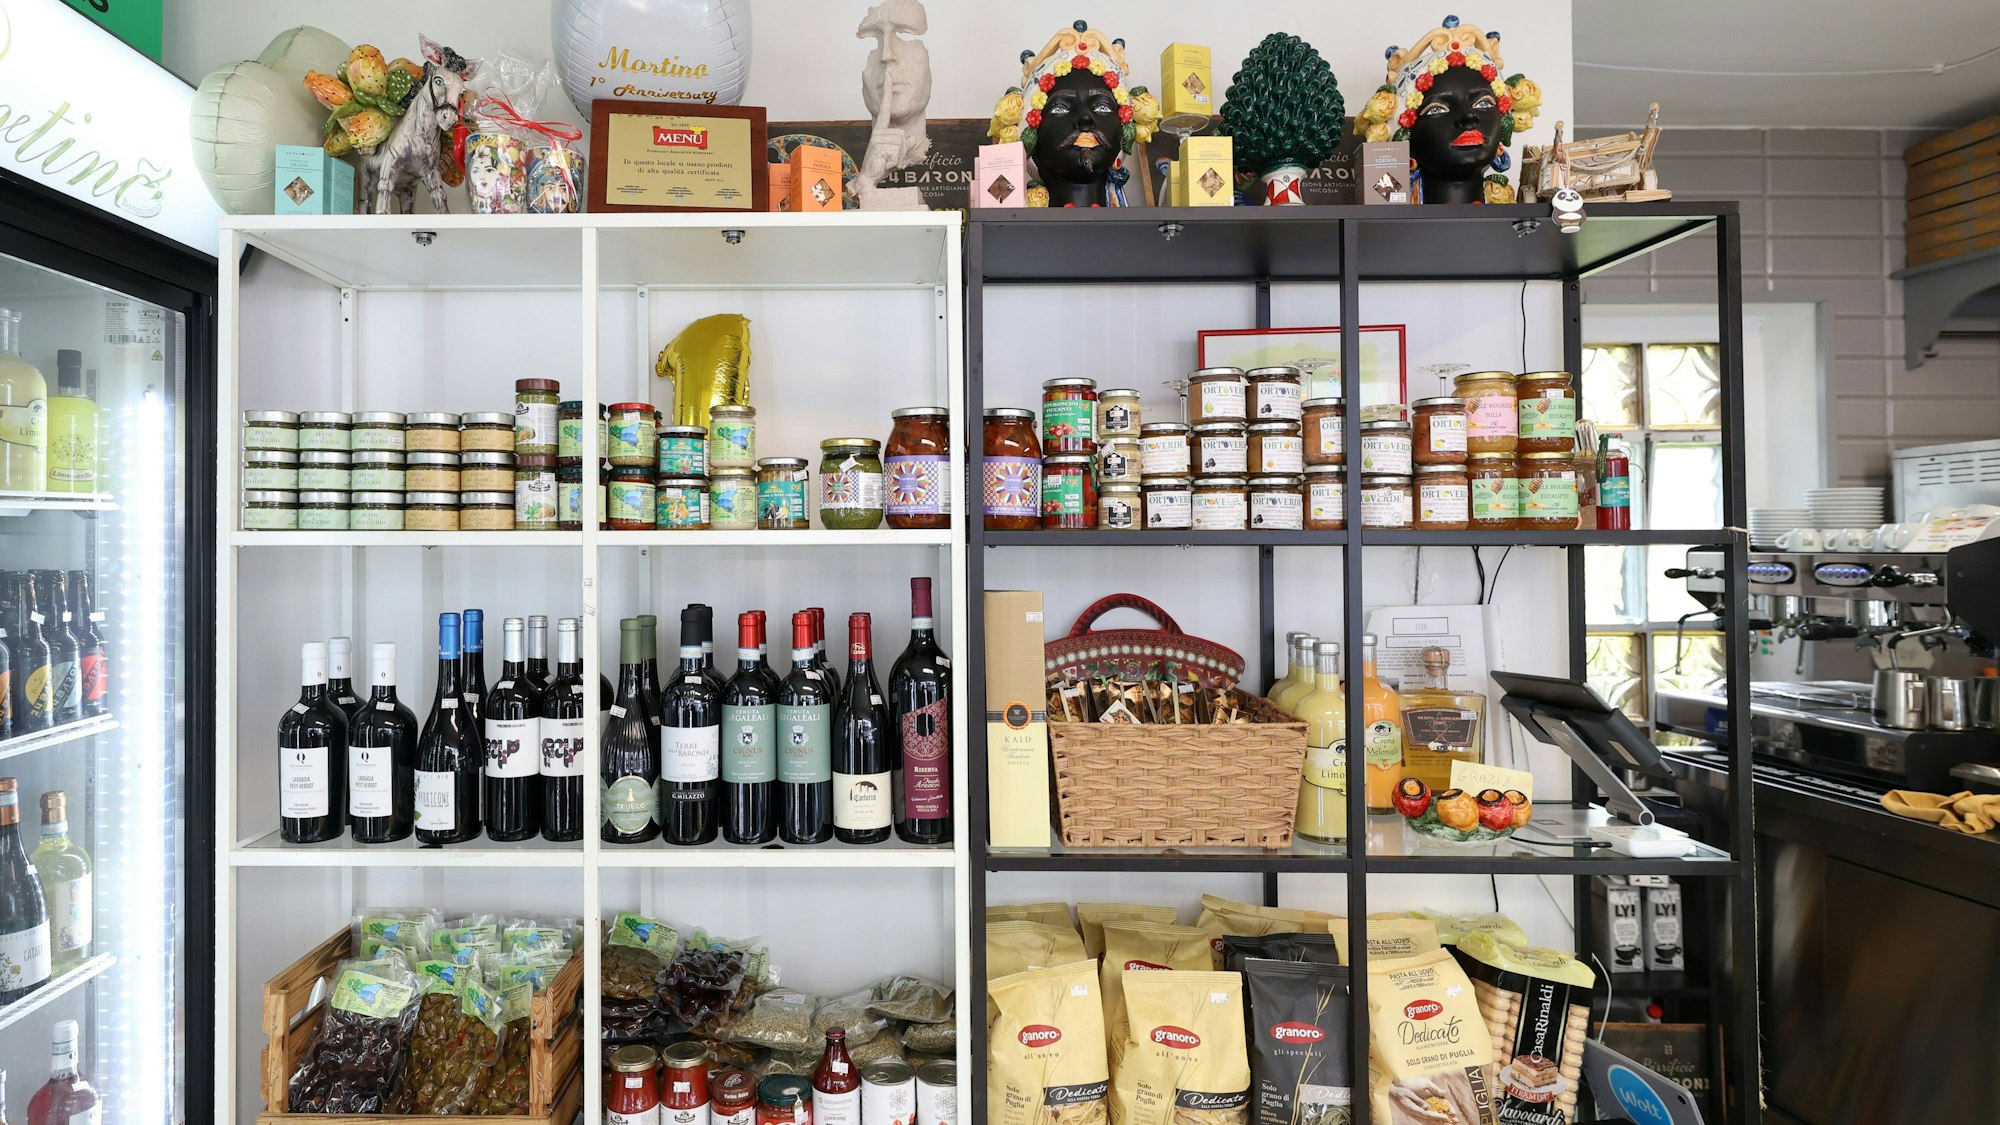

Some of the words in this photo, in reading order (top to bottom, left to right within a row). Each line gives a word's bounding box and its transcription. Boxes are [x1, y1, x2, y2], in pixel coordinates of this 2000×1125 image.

[613, 84, 718, 104] Anniversary
[662, 168, 684, 176] qualità
[880, 171, 900, 183] 4
[728, 714, 768, 722] REGALEALI
[780, 714, 820, 722] REGALEALI
[1372, 736, 1395, 744] Crema
[296, 752, 305, 764] Q
[361, 752, 369, 763] Q
[678, 750, 710, 758] BARONIA
[1458, 770, 1512, 788] GRAZIE
[418, 792, 450, 804] PERRICONE
[1615, 904, 1636, 918] LY!
[1655, 904, 1676, 916] LY!
[1408, 968, 1434, 976] ALL'UOVO
[1408, 1004, 1438, 1018] granoro
[1530, 984, 1555, 1064] CasaRinaldi
[1022, 1029, 1057, 1044] ganoro
[1155, 1030, 1196, 1044] granoro
[1275, 1026, 1320, 1040] granoro
[1398, 1016, 1463, 1046] Dedicato
[1156, 1052, 1198, 1062] all'uovo
[1274, 1048, 1284, 1056] gli
[1406, 1058, 1420, 1067] SOLO
[1422, 1055, 1438, 1064] GRANO
[1449, 1049, 1474, 1058] PUGLIA
[1006, 1084, 1020, 1094] Solo
[1138, 1082, 1152, 1090] Solo
[1262, 1083, 1278, 1092] Solo
[1006, 1092, 1024, 1102] grano
[1137, 1088, 1156, 1098] grano
[1183, 1092, 1245, 1106] Dedicato
[1261, 1092, 1282, 1100] grano
[1005, 1098, 1025, 1109] Puglia
[1136, 1094, 1156, 1106] Puglia
[1261, 1098, 1283, 1108] Puglia
[1618, 1086, 1664, 1120] Wolt
[1495, 1097, 1566, 1125] Savoiardi
